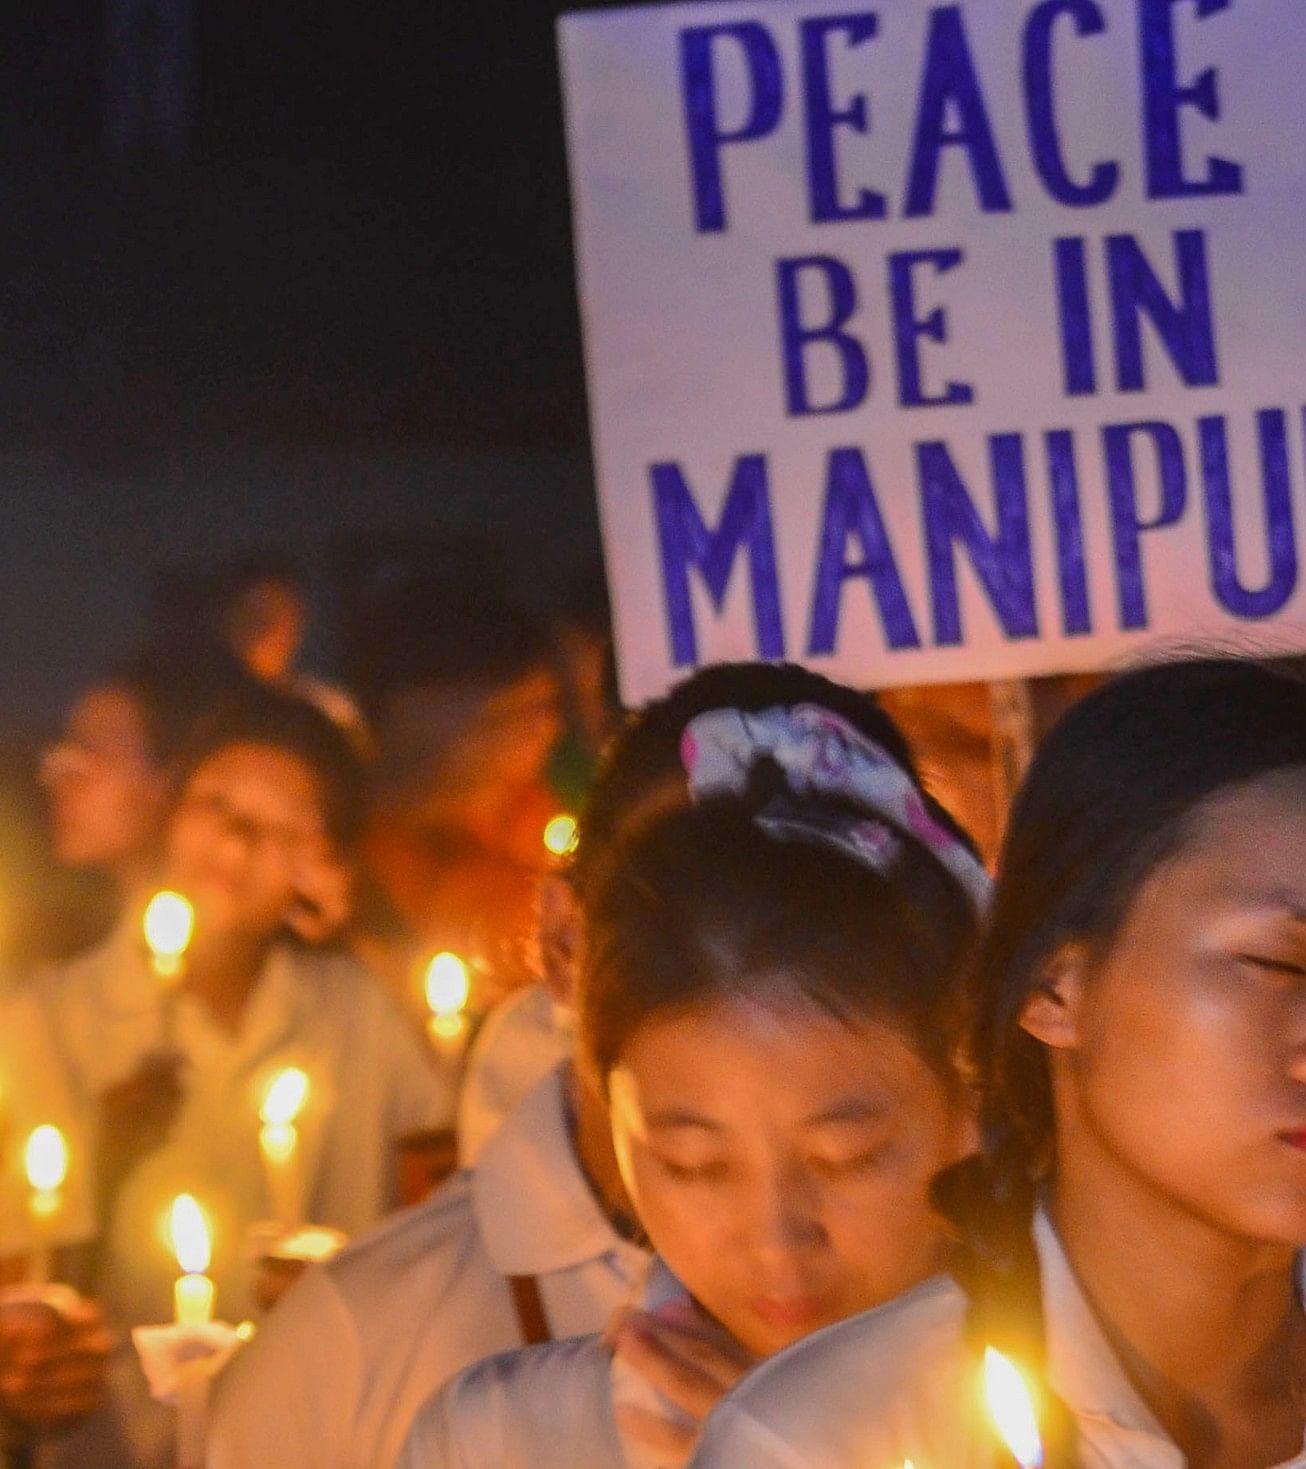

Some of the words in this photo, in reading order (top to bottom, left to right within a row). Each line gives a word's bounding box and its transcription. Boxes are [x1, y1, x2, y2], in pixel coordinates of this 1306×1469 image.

[679, 0, 1243, 233] PEACE
[775, 247, 976, 418] BE
[1052, 229, 1220, 397] IN
